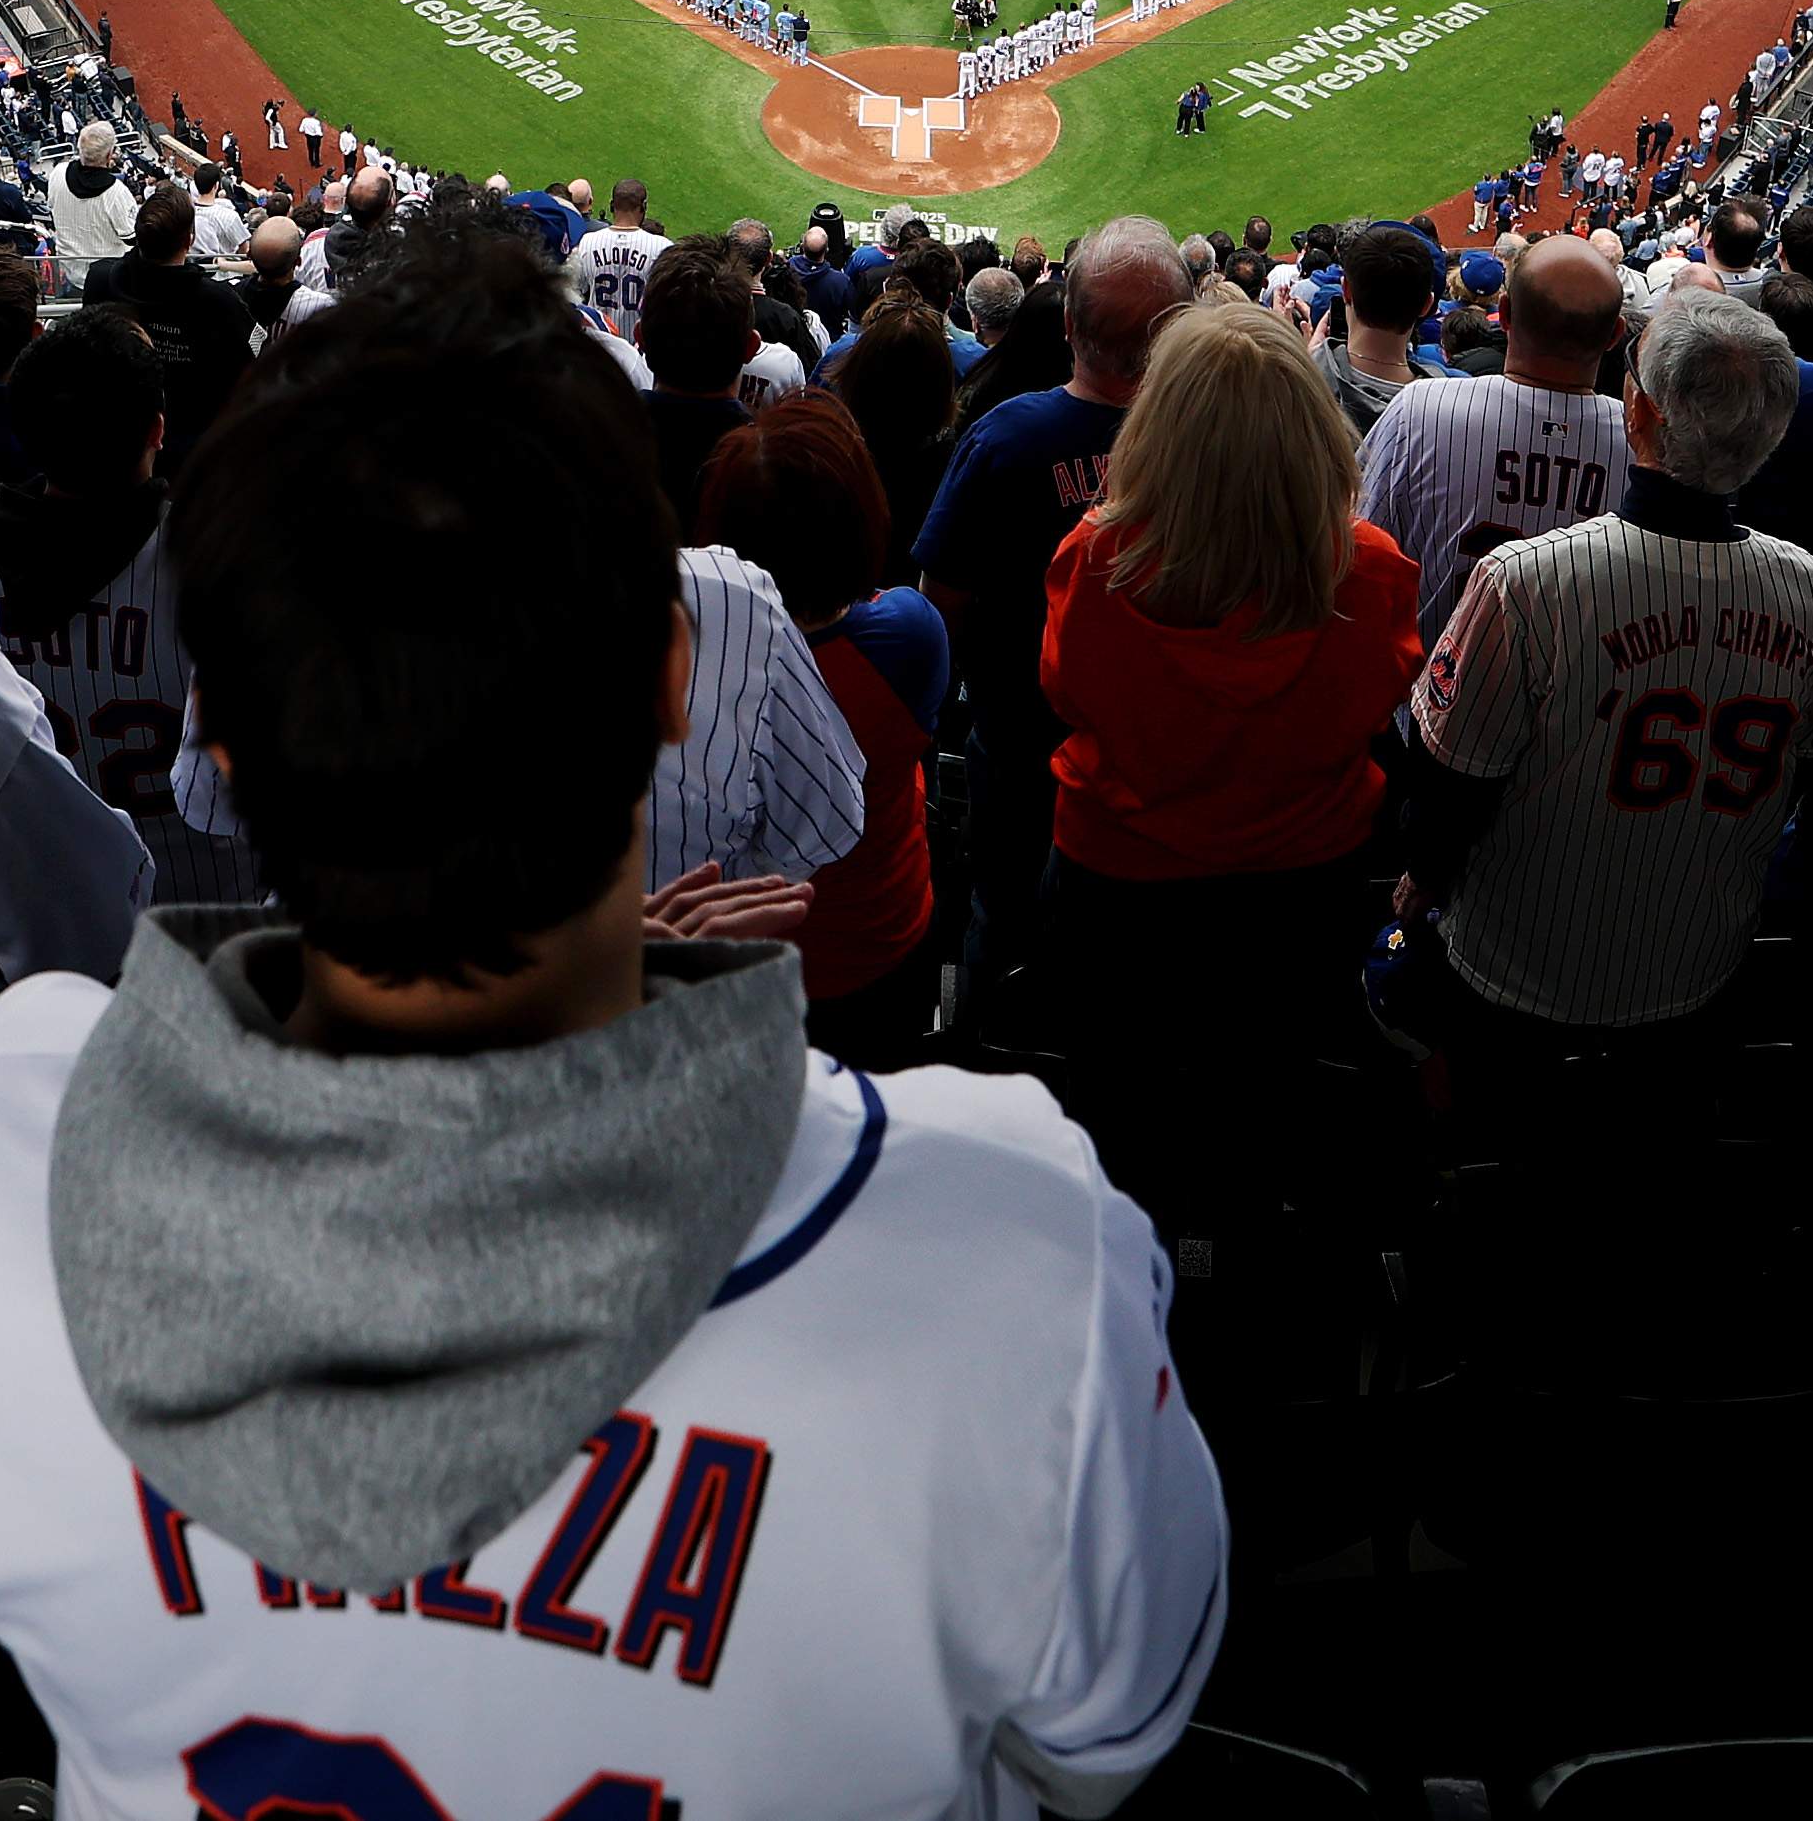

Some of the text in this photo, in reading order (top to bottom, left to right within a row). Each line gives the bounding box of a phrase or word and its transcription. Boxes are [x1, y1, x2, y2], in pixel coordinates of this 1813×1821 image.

[1270, 1, 1490, 110] Presbyterian
[592, 246, 648, 269] ALONSO
[944, 223, 999, 245] DAY
[593, 272, 644, 311] 20
[1495, 450, 1607, 517] SOTO
[1600, 604, 1699, 674] WORLD
[1596, 685, 1801, 817] '69
